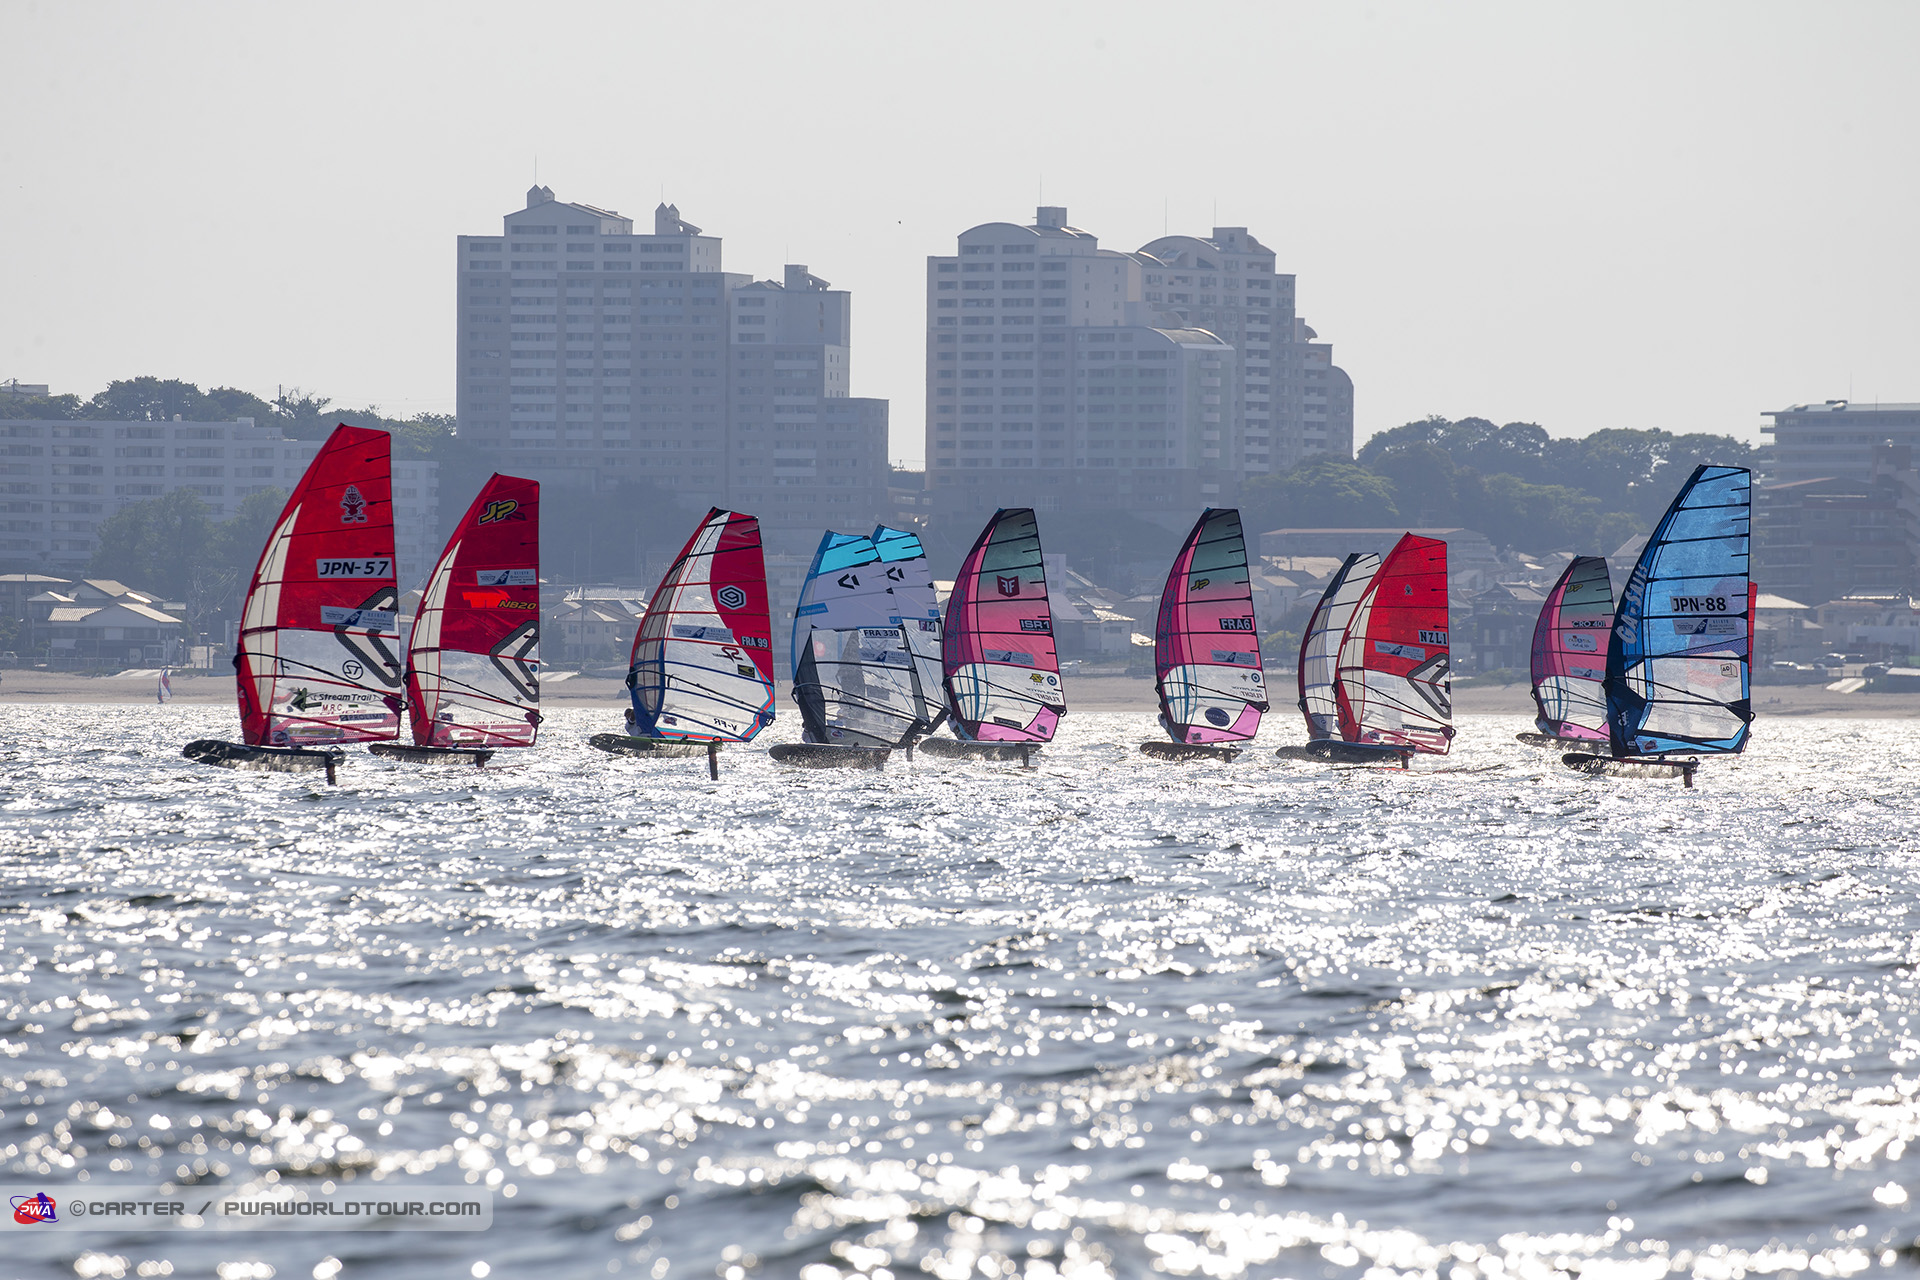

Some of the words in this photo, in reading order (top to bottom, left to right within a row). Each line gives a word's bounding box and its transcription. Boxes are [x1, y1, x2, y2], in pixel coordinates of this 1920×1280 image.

[1674, 597, 1727, 612] JPN-88
[1020, 620, 1051, 629] ISR1
[1221, 619, 1251, 630] FRA6
[741, 636, 756, 646] FRA
[757, 638, 768, 648] 99
[320, 693, 351, 701] Stream
